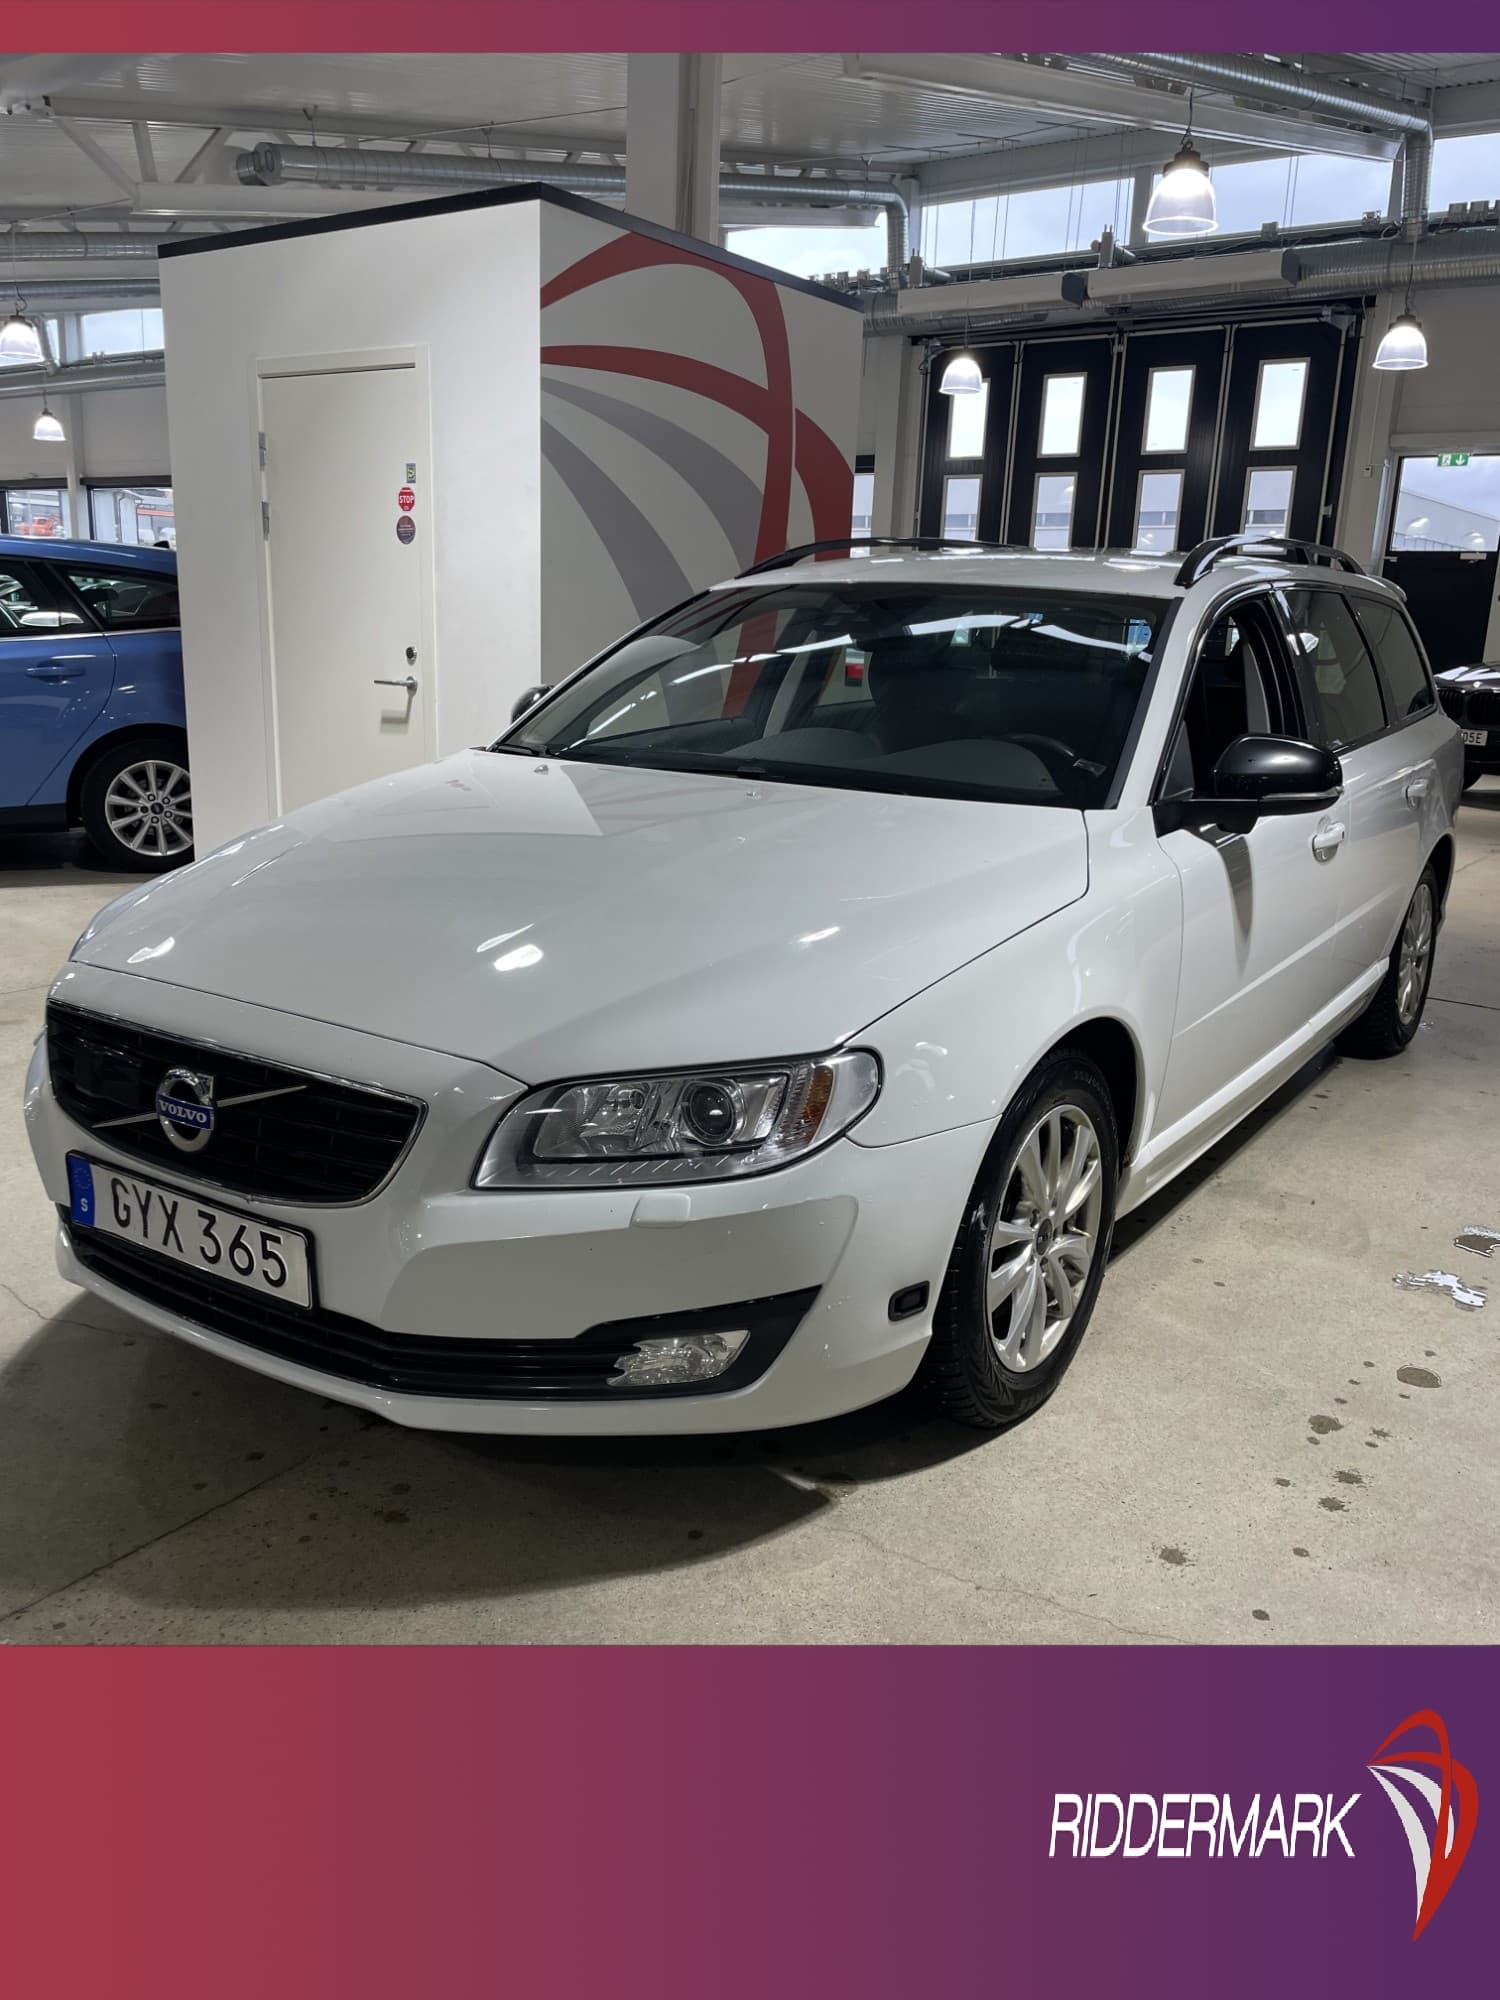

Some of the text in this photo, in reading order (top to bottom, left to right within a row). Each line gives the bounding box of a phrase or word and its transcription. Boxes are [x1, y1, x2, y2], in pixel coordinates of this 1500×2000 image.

[399, 495, 414, 504] STOP
[160, 1100, 207, 1123] VOLVO
[80, 1197, 88, 1213] S
[111, 1178, 287, 1288] GYX 365
